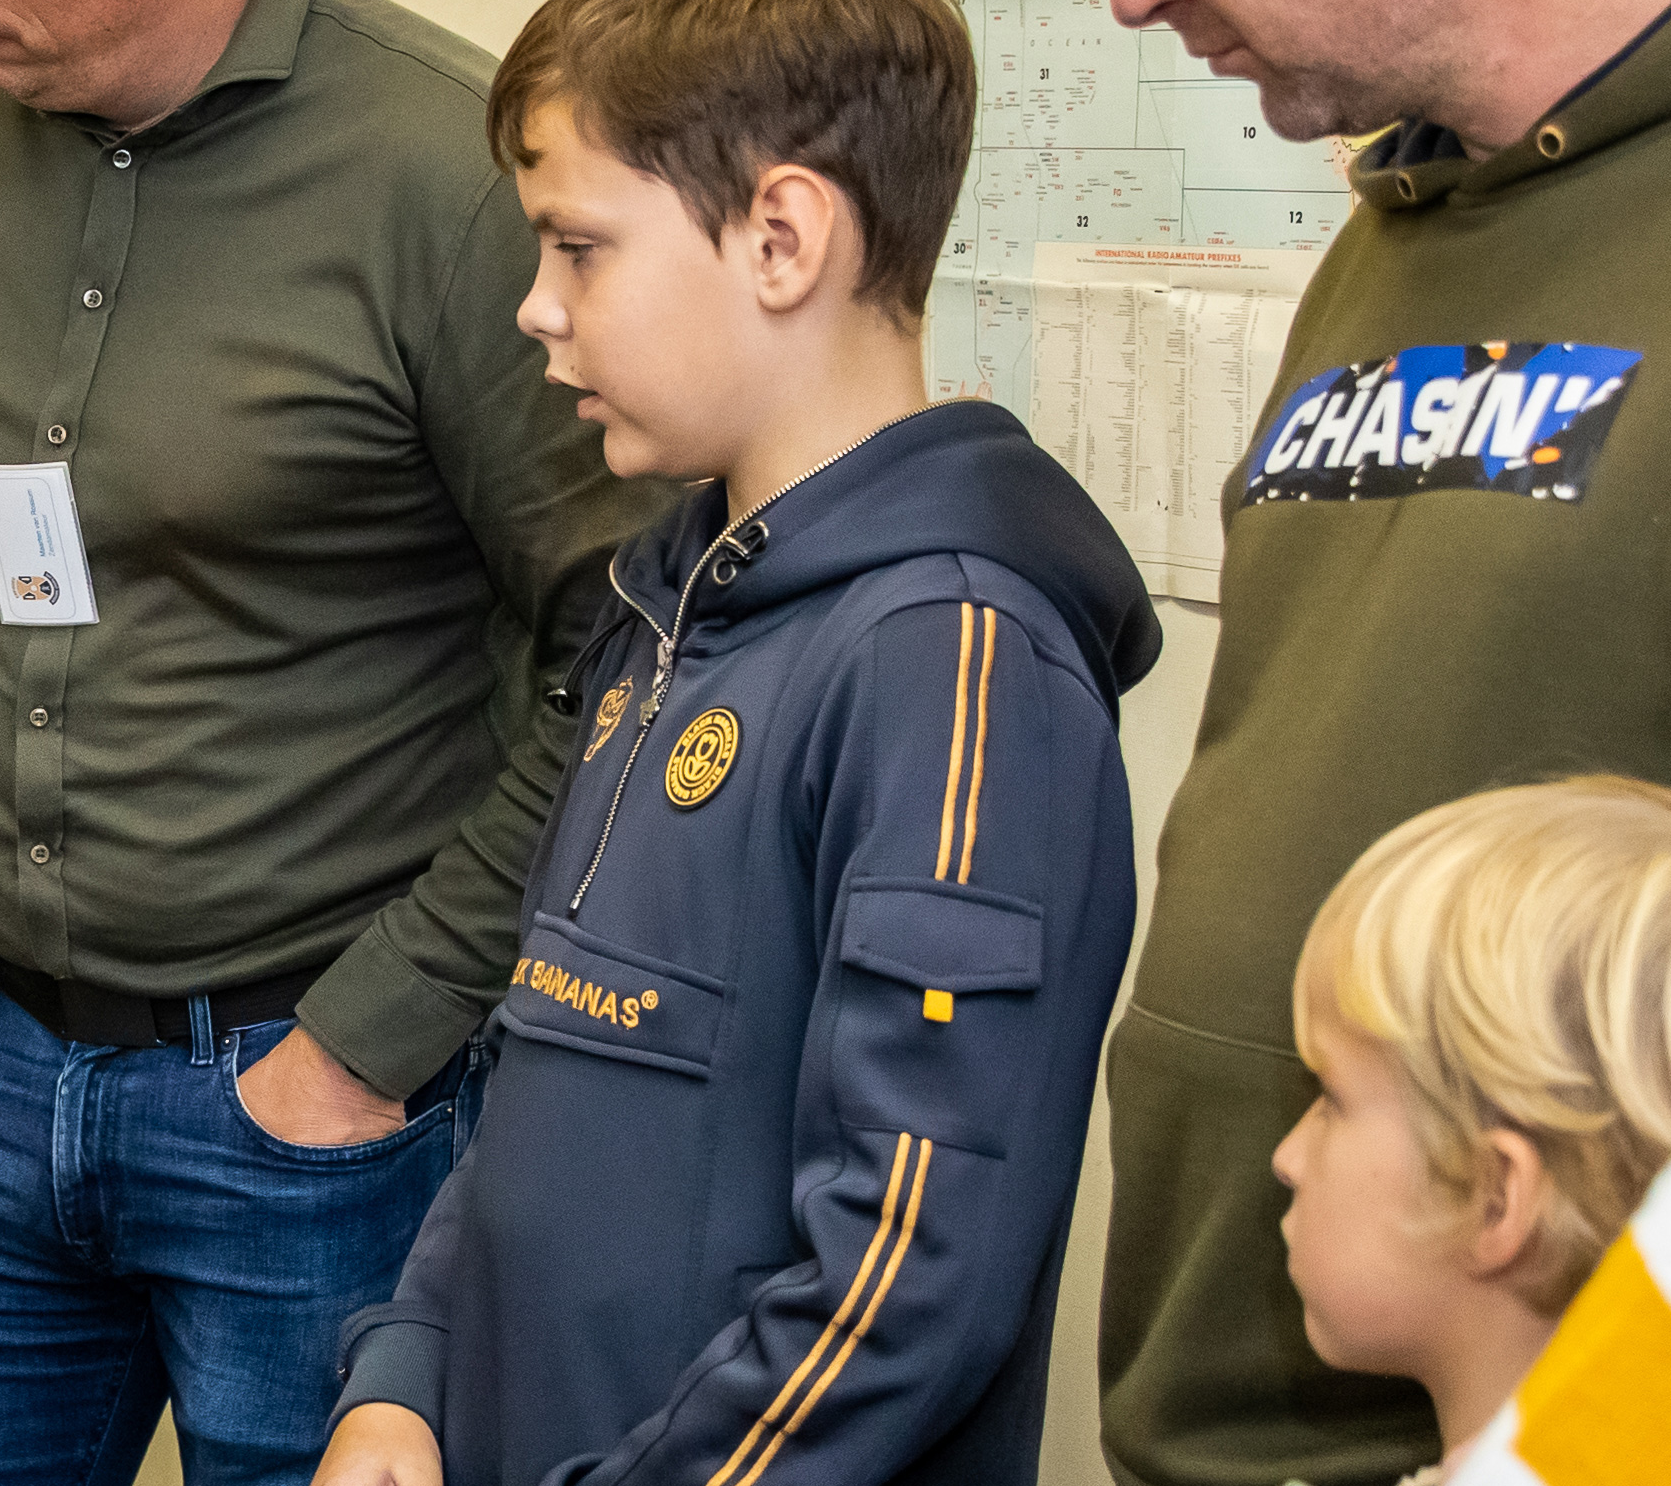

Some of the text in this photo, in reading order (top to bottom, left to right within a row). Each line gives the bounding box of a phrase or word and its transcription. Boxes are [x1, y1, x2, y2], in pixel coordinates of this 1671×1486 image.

[1039, 68, 1050, 81] 31
[1243, 126, 1257, 139] 10
[1076, 215, 1089, 228] 32
[1289, 211, 1303, 224] 12
[953, 242, 967, 255] 30
[1095, 249, 1242, 262] INTERNATIONAL RADIO AMATEUR PREFIXES
